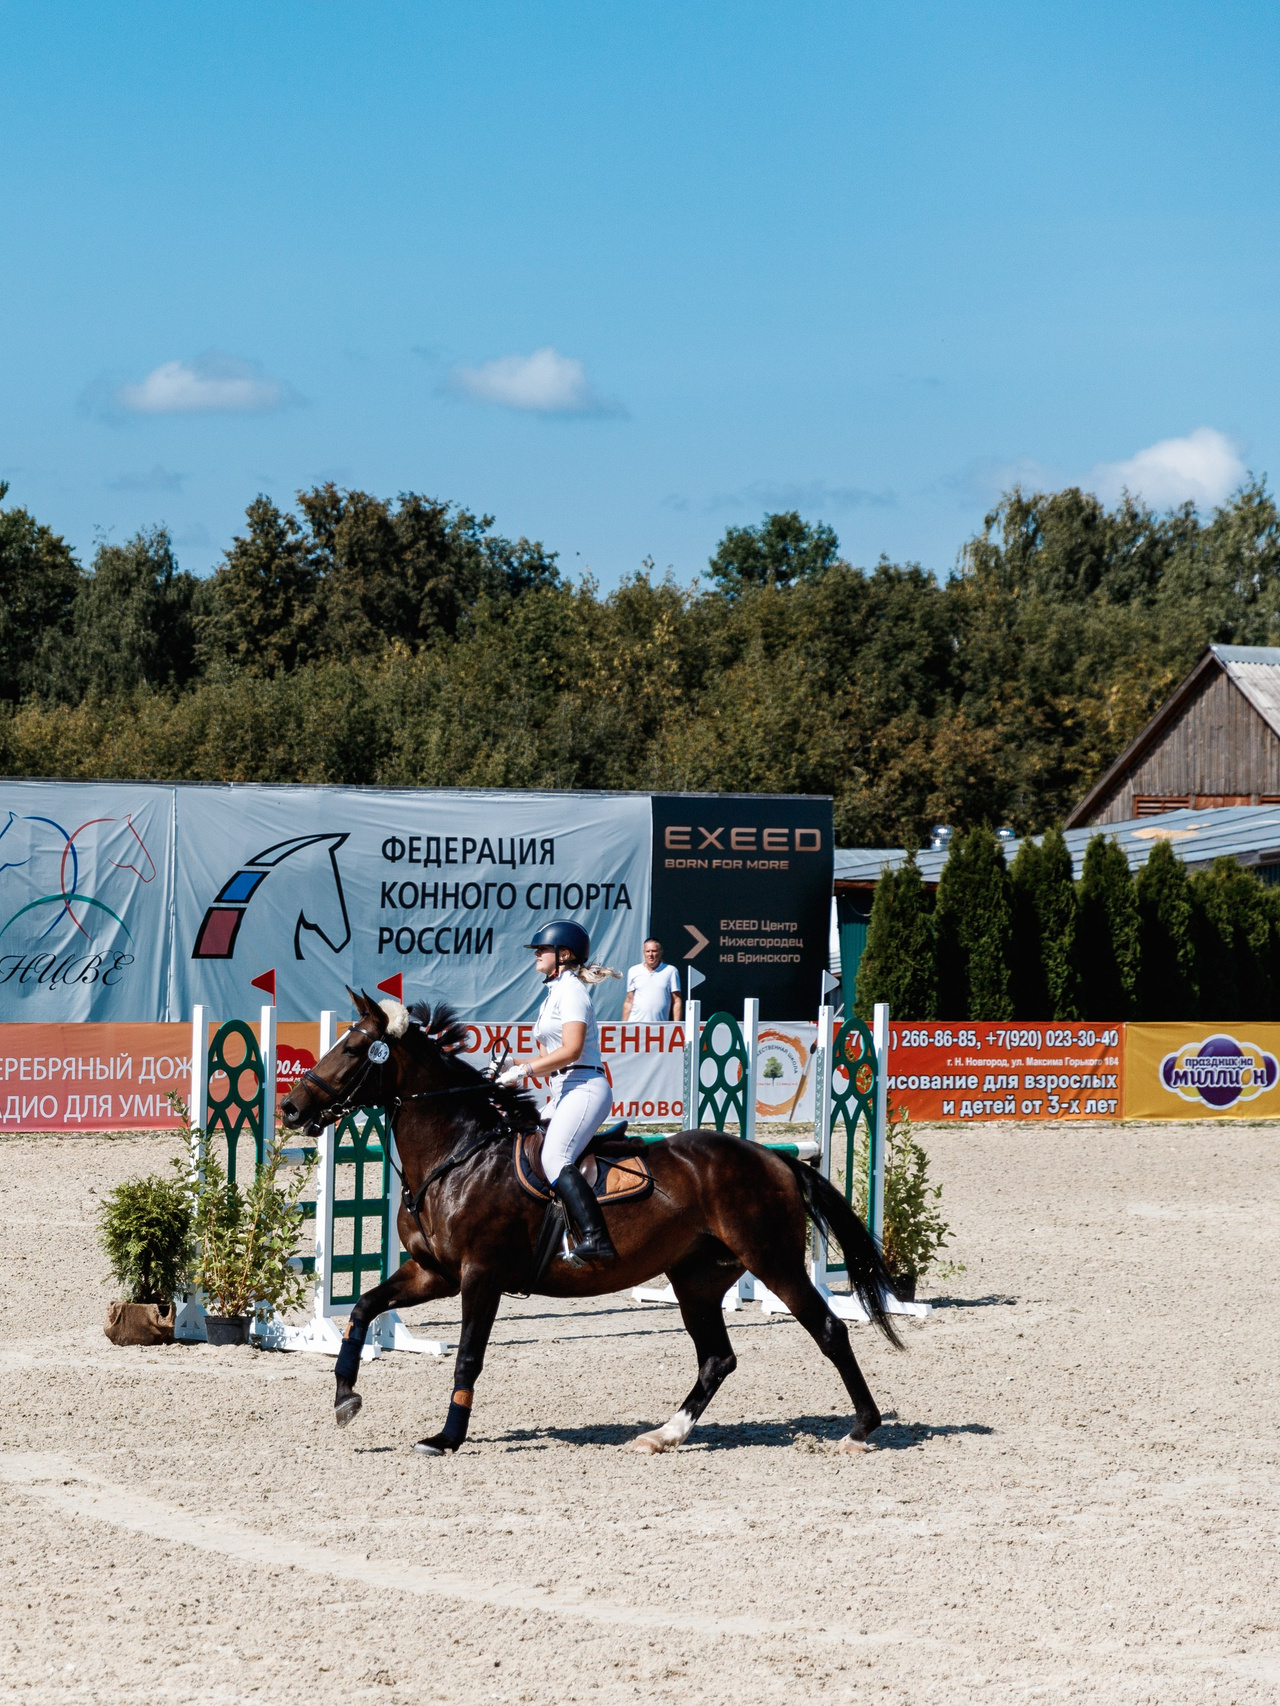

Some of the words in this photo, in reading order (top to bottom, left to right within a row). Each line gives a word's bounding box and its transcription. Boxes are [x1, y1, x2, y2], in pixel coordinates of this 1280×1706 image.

[664, 826, 821, 851] EXEED
[381, 836, 555, 869] ФЕДЕРАЦИЯ
[664, 859, 708, 868] BORN
[712, 859, 743, 869] FOR
[746, 860, 790, 870] MORE
[380, 881, 518, 910] КОННОГО
[525, 882, 633, 910] СПОРТА
[720, 919, 759, 931] EXEED
[761, 920, 798, 933] Центр
[377, 926, 494, 955] РОССИИ
[720, 935, 804, 949] Нижегородец
[720, 954, 734, 963] на
[737, 952, 801, 965] Бринского
[901, 1029, 981, 1050] 266-86-85,
[985, 1029, 1042, 1051] +7(920)
[1045, 1029, 1119, 1048] 023-30-40
[954, 1058, 964, 1067] Н.
[965, 1058, 1010, 1068] Новгород,
[1011, 1059, 1025, 1068] ул.
[1026, 1057, 1064, 1067] Максима
[1064, 1057, 1103, 1068] Горького
[1185, 1057, 1238, 1069] праздник
[1240, 1057, 1254, 1067] на
[887, 1074, 979, 1090] исование
[982, 1074, 1019, 1093] для
[1024, 1073, 1118, 1094] взрослых
[63, 1094, 113, 1123] ДЛЯ
[119, 1093, 193, 1118] УМНЫ
[942, 1099, 956, 1115] и
[959, 1094, 1017, 1119] детей
[1021, 1099, 1043, 1115] от
[1047, 1094, 1081, 1115] 3-х
[1084, 1098, 1118, 1115] лет
